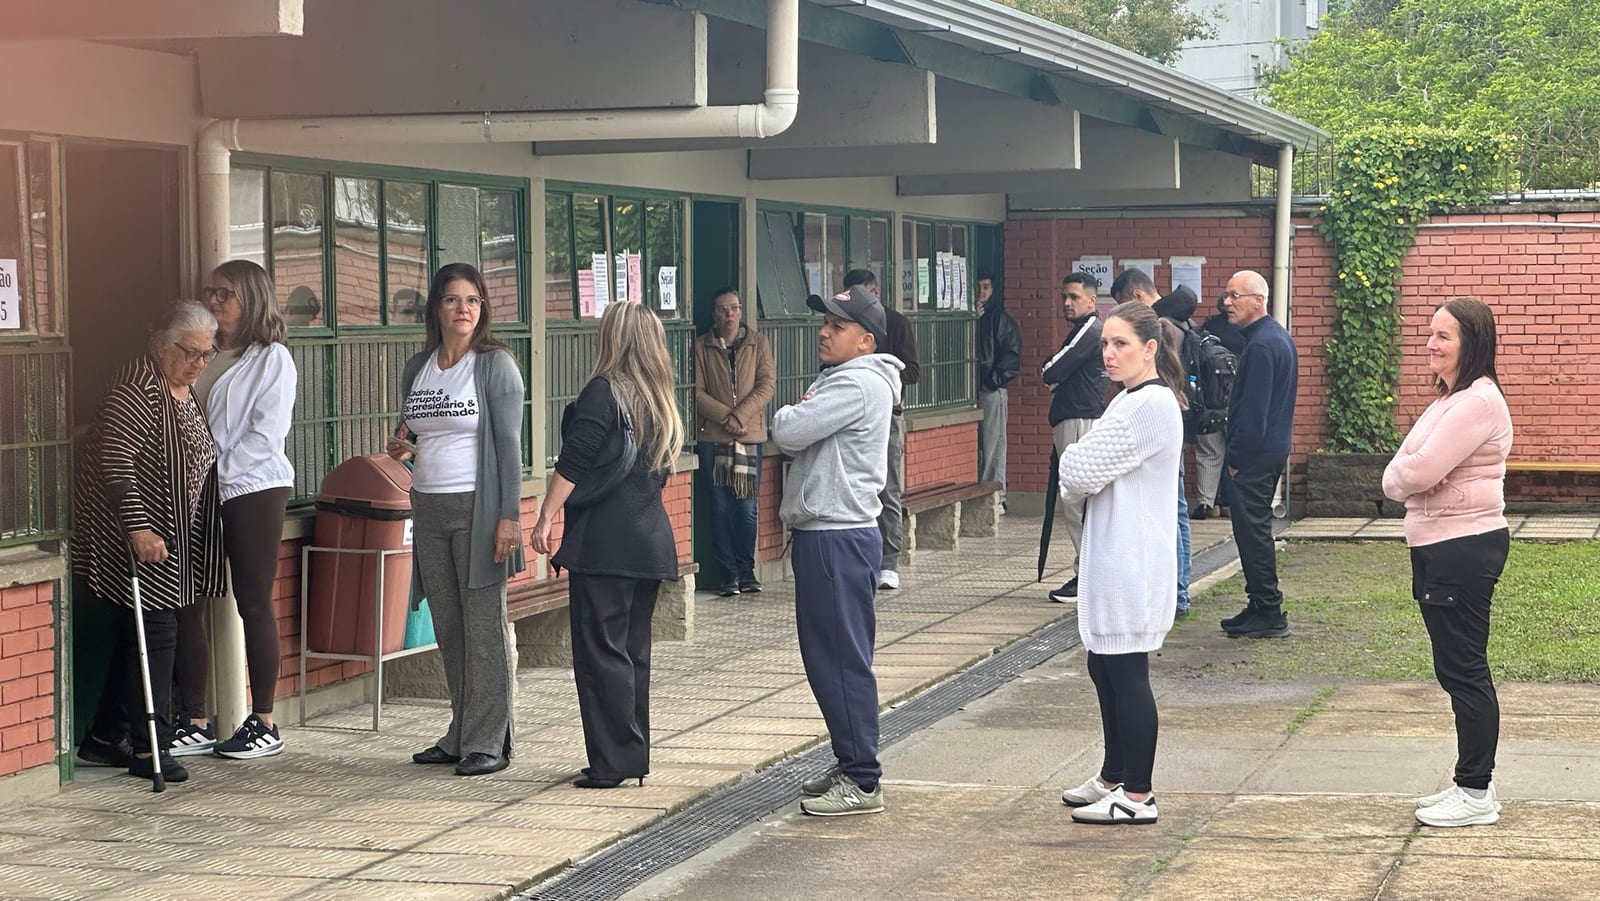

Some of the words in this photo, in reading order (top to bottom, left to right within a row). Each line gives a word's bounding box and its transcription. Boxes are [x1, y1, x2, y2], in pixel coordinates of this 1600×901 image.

[1078, 263, 1108, 276] Seção
[1096, 278, 1103, 287] 6
[0, 301, 7, 320] 5
[408, 388, 436, 397] adrão
[436, 388, 444, 396] &
[443, 394, 451, 402] &
[467, 399, 476, 408] &
